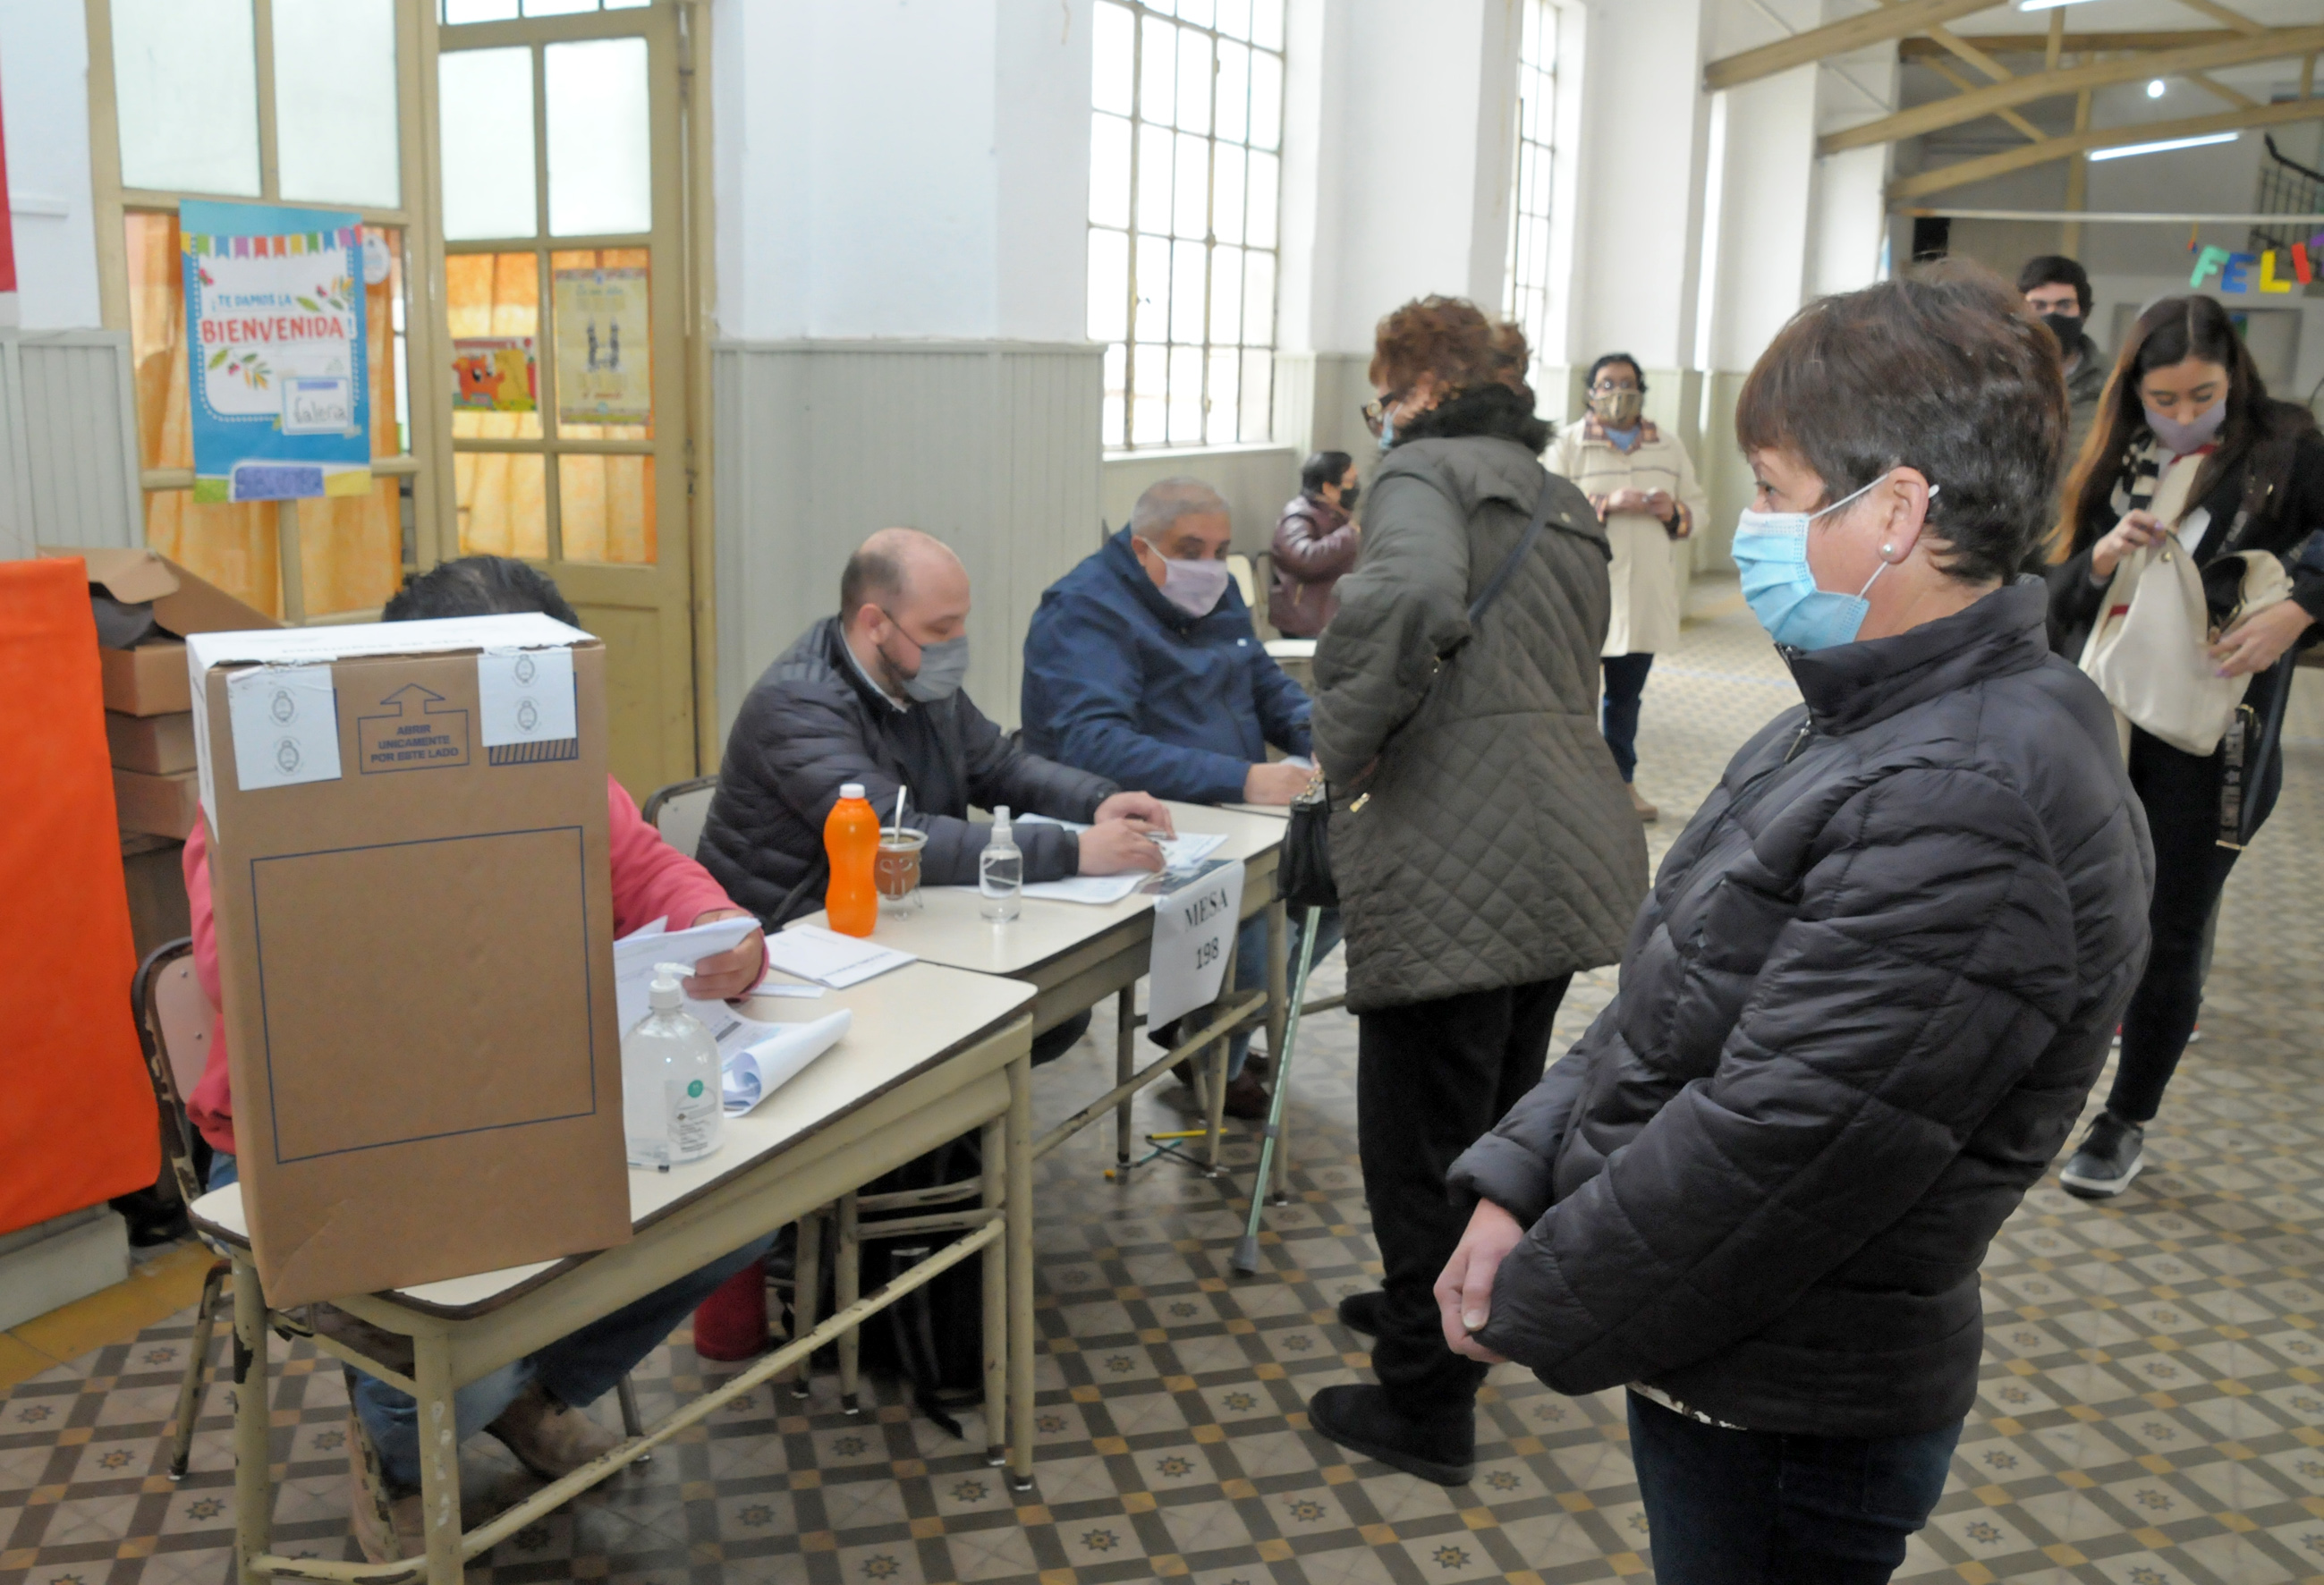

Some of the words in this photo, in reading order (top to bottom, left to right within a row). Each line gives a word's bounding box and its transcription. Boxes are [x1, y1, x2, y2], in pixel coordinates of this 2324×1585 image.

[234, 293, 276, 307] DAMOS
[278, 294, 293, 307] LA
[396, 724, 431, 735] ABRIR
[378, 734, 451, 750] UNICAMENTE
[370, 752, 394, 763] POR
[397, 750, 426, 761] ESTE
[428, 747, 459, 759] LADO
[1184, 886, 1228, 931] MESA
[1196, 937, 1220, 970] 198
